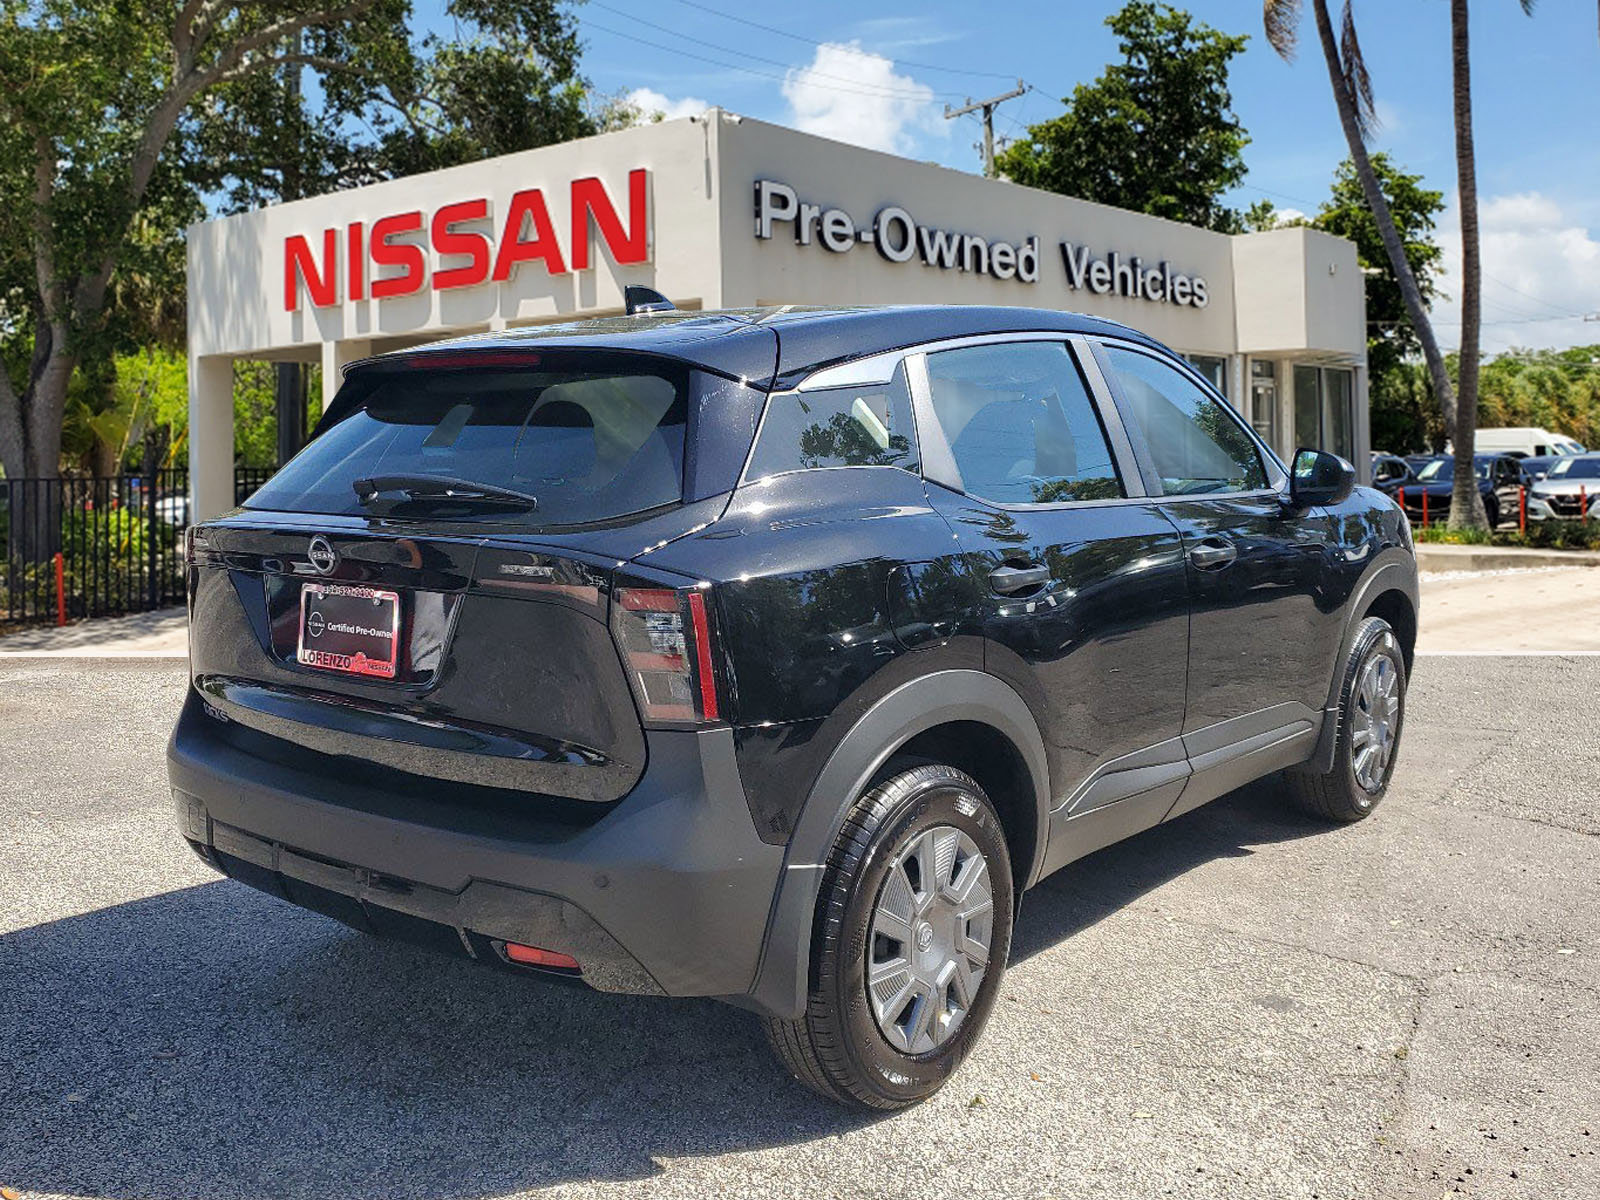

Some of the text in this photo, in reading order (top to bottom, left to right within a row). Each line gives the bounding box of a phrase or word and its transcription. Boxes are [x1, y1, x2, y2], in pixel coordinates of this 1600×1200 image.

[284, 168, 648, 311] NISSAN
[754, 179, 1209, 309] Pre-Owned Vehicles
[301, 651, 351, 668] LORENZO
[327, 622, 355, 634] Certified
